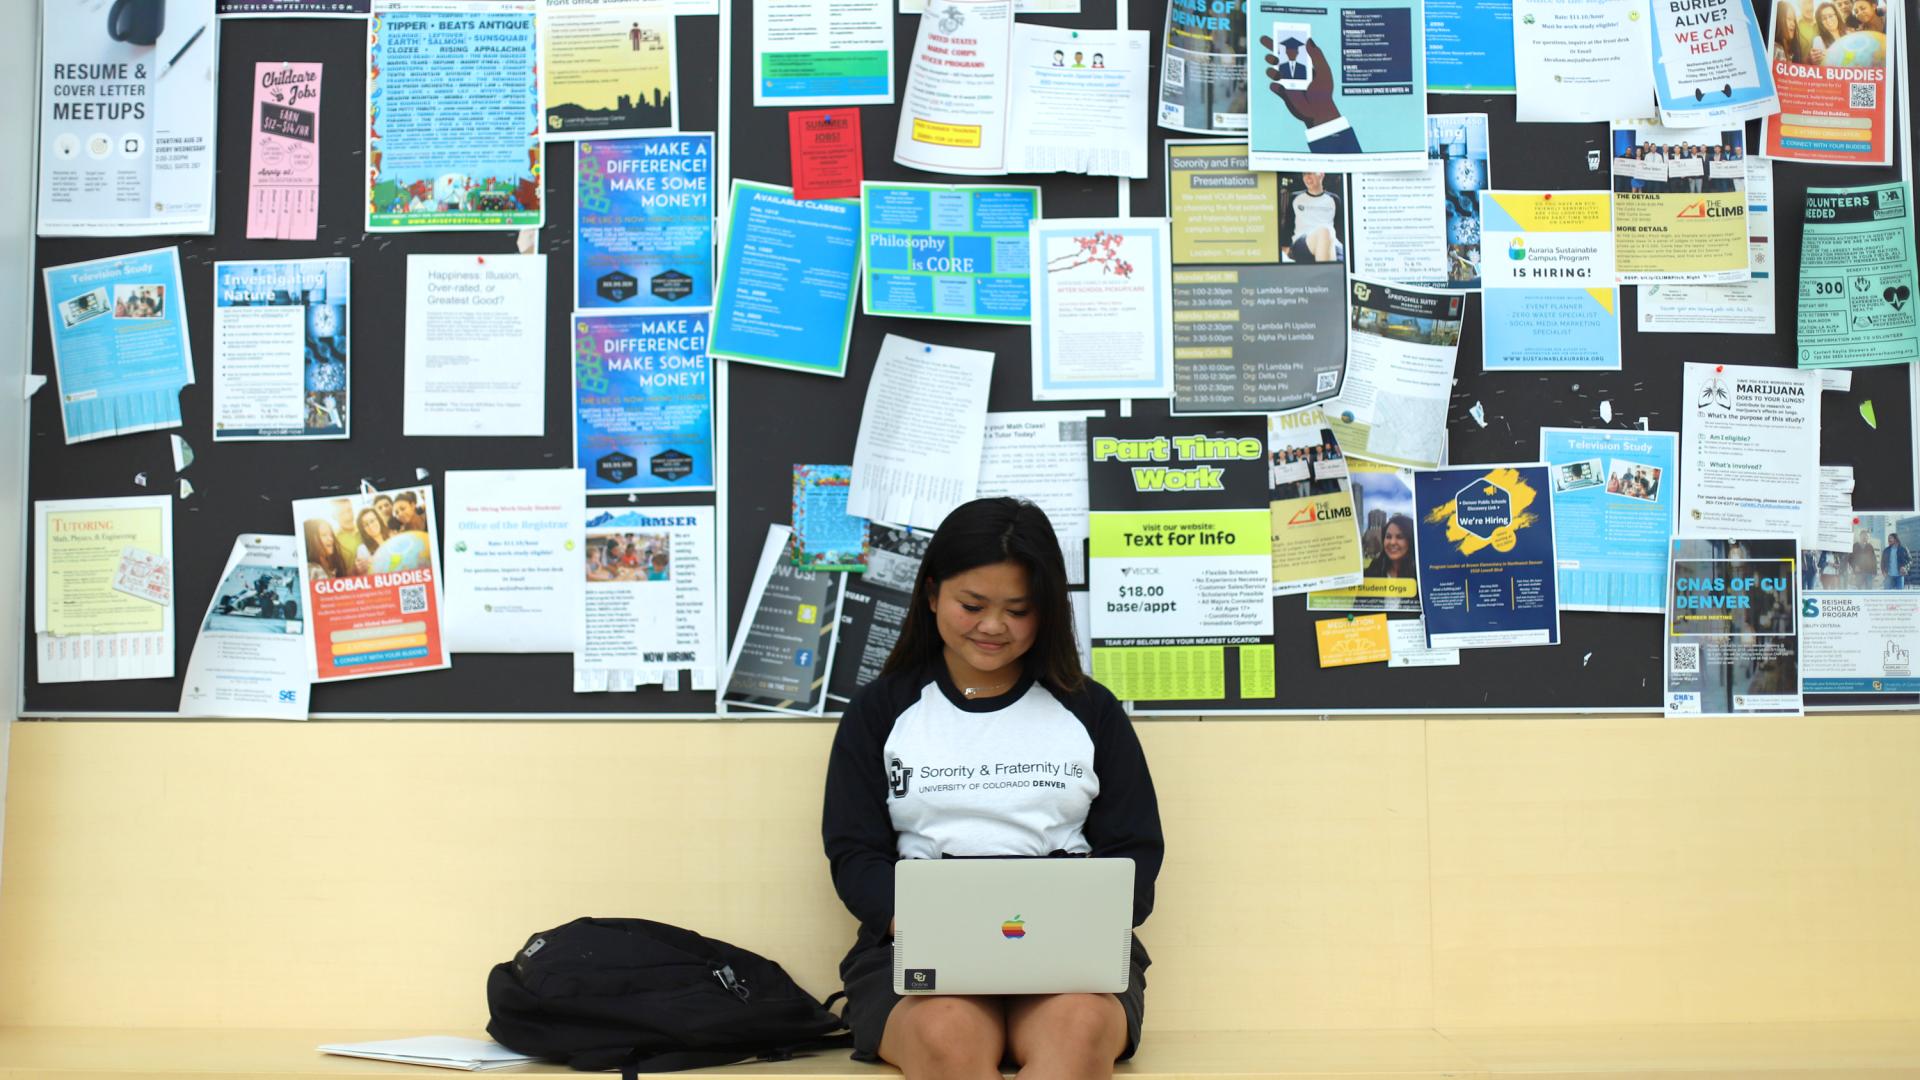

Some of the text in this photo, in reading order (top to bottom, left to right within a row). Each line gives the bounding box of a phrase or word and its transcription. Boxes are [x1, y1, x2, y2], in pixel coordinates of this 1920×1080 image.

[1173, 9, 1232, 30] DENVER
[1675, 9, 1727, 27] ALIVE?
[387, 21, 529, 30] TIPPER BEATS ANTIQUE
[951, 37, 977, 45] STATES
[1675, 25, 1734, 43] WE CAN
[951, 48, 976, 56] CORPS
[1690, 40, 1727, 54] HELP
[54, 64, 147, 79] RESUME &
[262, 70, 317, 87] Childcare
[1776, 63, 1884, 81] GLOBAL BUDDIES
[54, 85, 145, 96] COVER LETTER
[289, 85, 317, 105] Jobs
[53, 103, 145, 119] MEETUPS
[280, 109, 299, 123] EARN
[806, 120, 848, 130] SUMMER
[815, 133, 840, 143] JOBS!
[645, 142, 706, 156] MAKE A
[607, 159, 706, 173] DIFFERENCE!
[1174, 158, 1208, 169] Sorority
[1211, 158, 1228, 167] and
[611, 177, 706, 191] MAKE SOME
[1193, 176, 1254, 186] Presentations
[642, 194, 706, 207] MONEY!
[1707, 206, 1743, 218] CLIMB
[871, 233, 945, 251] Philosophy
[913, 257, 973, 272] is CORE
[71, 264, 152, 283] Television Study
[429, 271, 480, 281] Happiness:
[1513, 268, 1592, 277] IS HIRING!
[224, 275, 324, 287] Investigating
[1816, 282, 1843, 294] 300
[224, 291, 276, 301] Nature
[1354, 282, 1371, 300] CU
[427, 295, 469, 305] Greatest
[642, 320, 704, 334] MAKE A
[604, 337, 704, 353] DIFFERENCE!
[609, 355, 704, 371] MAKE SOME
[640, 372, 704, 387] MONEY!
[1737, 384, 1804, 396] MARIJUANA
[1093, 435, 1262, 461] Part Time
[1569, 440, 1652, 453] Television Study
[1132, 465, 1225, 492] Work
[1317, 507, 1351, 521] CLIMB
[53, 519, 113, 532] TUTORING
[459, 521, 488, 529] Office
[522, 520, 568, 530] Registrar
[641, 517, 696, 526] RMSER
[1460, 517, 1508, 526] We're Hiring
[1124, 532, 1235, 546] Text for Info
[315, 569, 431, 594] GLOBAL BUDDIES
[1677, 578, 1786, 592] CNAS OF CU
[1119, 586, 1163, 598] $18.00
[1107, 602, 1176, 613] base/appt
[1677, 596, 1750, 609] DENVER
[643, 652, 695, 662] NOW HIRING
[921, 761, 1083, 779] Sorority & Fraternity Life
[891, 758, 913, 798] CU
[920, 784, 965, 793] UNIVERSITY
[983, 781, 1030, 789] COLORADO
[1033, 781, 1066, 789] DENVER
[914, 972, 926, 982] CU
